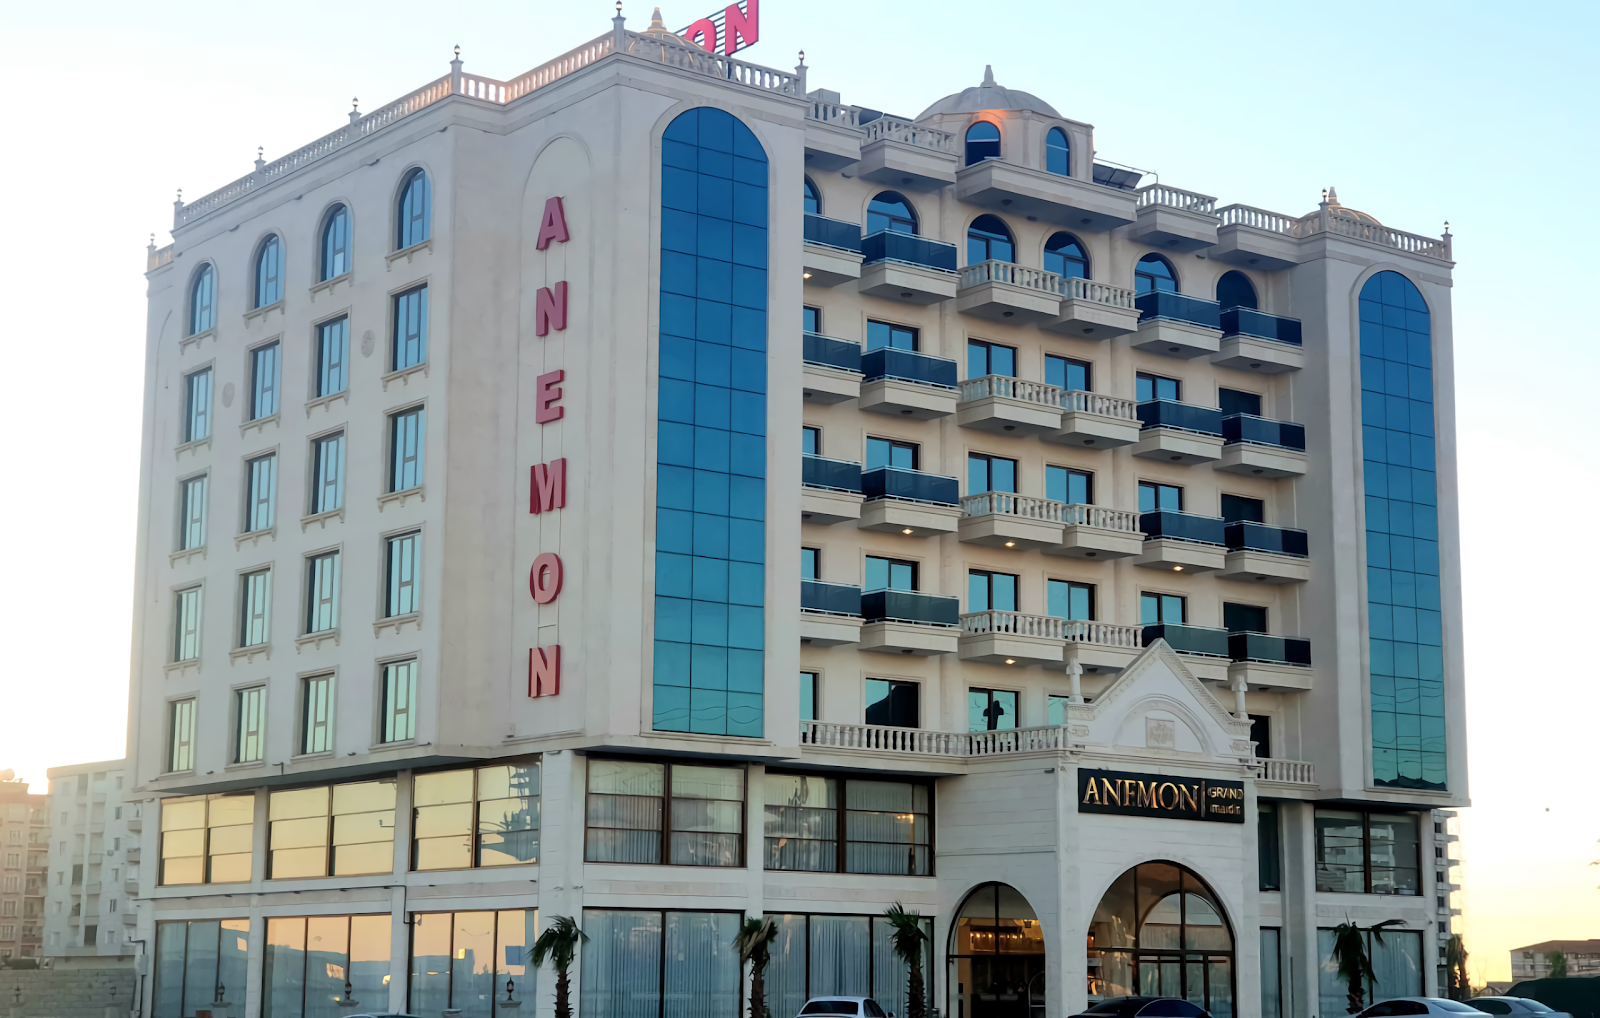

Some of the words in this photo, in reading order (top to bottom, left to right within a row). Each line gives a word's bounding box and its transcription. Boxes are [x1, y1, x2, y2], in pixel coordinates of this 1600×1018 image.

[683, 0, 759, 56] ON
[528, 196, 570, 698] ANEMON
[1082, 776, 1199, 812] ANEMON
[1207, 786, 1244, 800] GRAND
